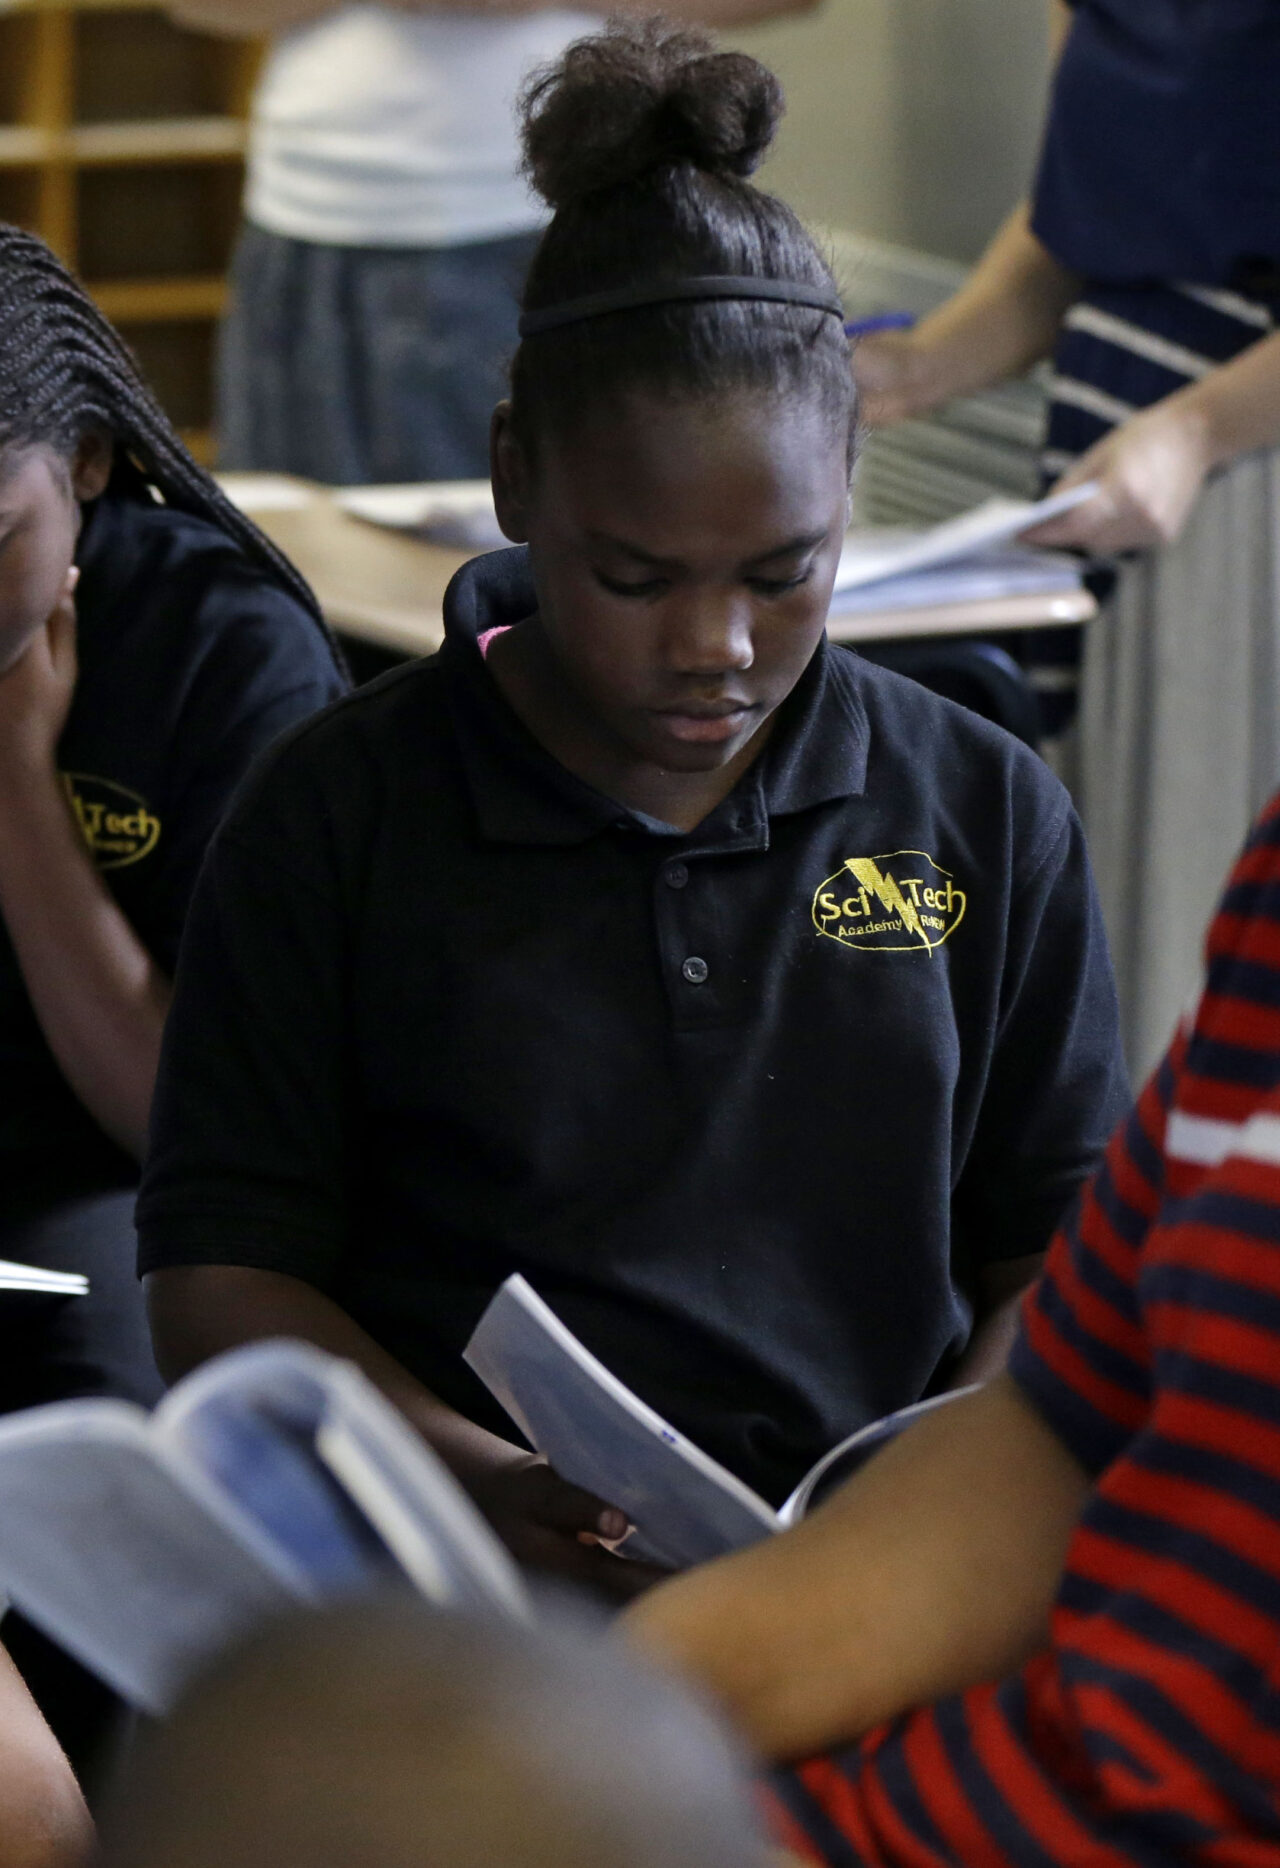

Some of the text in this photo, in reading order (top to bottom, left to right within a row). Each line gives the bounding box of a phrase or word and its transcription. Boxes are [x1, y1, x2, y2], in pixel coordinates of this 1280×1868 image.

[85, 803, 161, 837] Tech
[820, 879, 967, 920] Sci Tech
[838, 918, 904, 938] Academy
